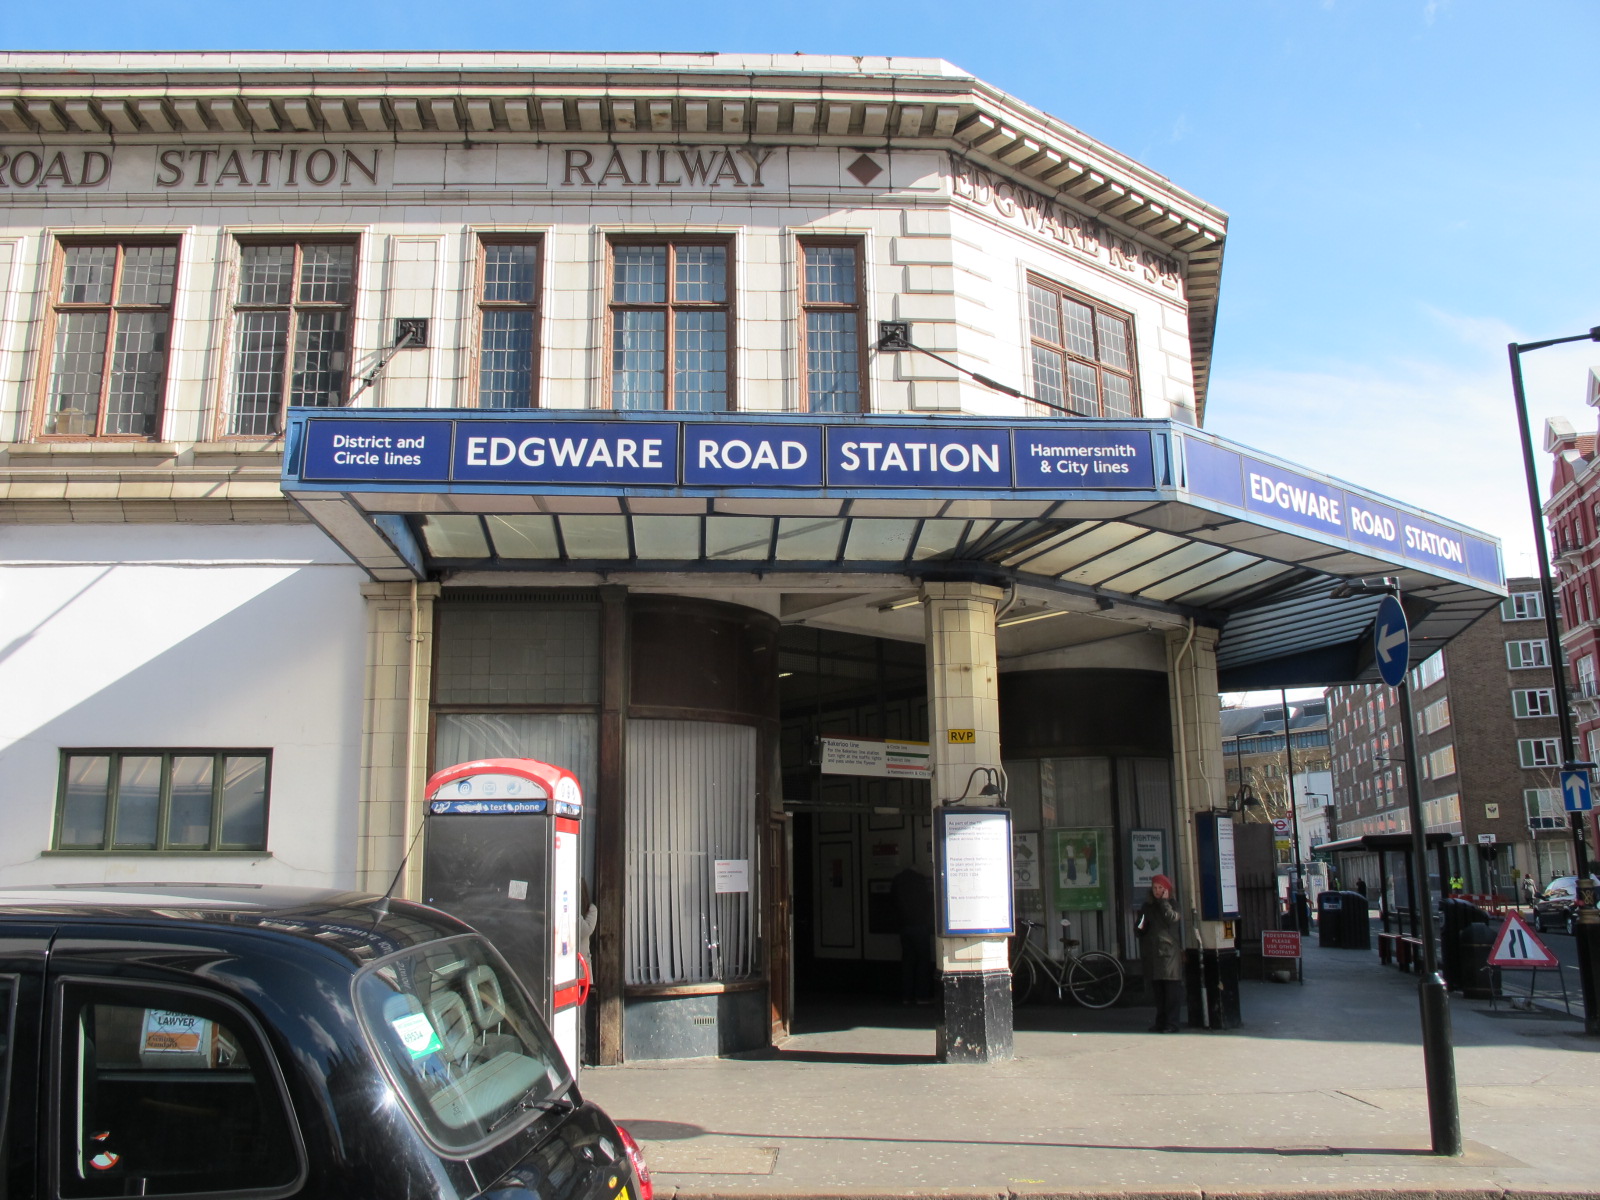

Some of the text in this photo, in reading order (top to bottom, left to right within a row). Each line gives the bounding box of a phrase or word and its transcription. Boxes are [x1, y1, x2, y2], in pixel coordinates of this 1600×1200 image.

[0, 149, 382, 187] OAD STATION
[561, 149, 776, 187] RAILWAY
[951, 154, 1100, 258] EDGWARE
[333, 434, 425, 449] District and
[466, 436, 1000, 473] EDGWARE ROAD STATION
[1030, 443, 1136, 457] Hammersmith
[333, 451, 421, 466] Circle lines
[1040, 459, 1129, 476] & City lines
[1249, 472, 1463, 564] EDGWARE ROAD STATION
[950, 731, 974, 741] RVP
[490, 803, 507, 811] text
[513, 803, 540, 813] phone
[157, 1016, 195, 1027] LAWYER
